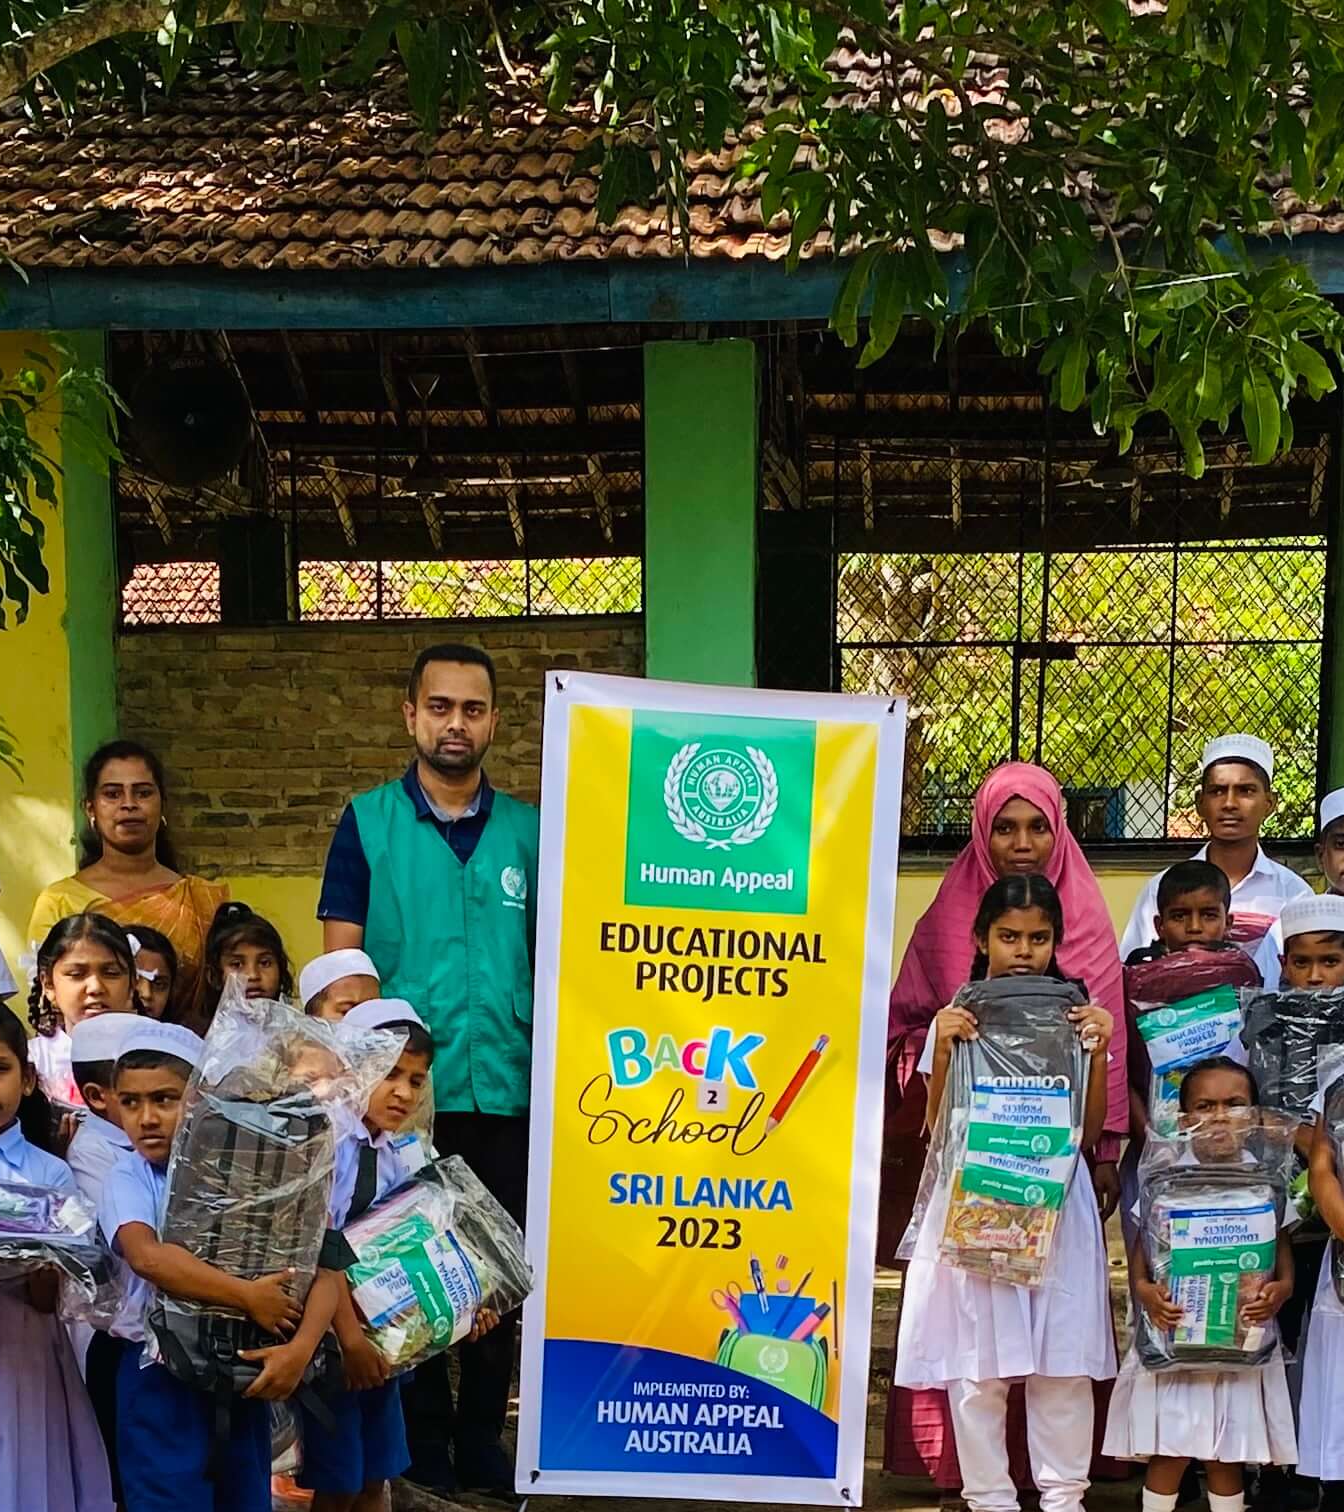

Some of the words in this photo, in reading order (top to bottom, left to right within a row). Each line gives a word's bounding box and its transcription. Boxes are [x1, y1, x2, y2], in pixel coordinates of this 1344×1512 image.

[687, 754, 721, 786] HUMAN
[725, 755, 757, 788] APPEAL
[691, 805, 750, 827] AUSTRALIA
[639, 863, 716, 888] Human
[720, 868, 794, 895] Appeal
[599, 921, 828, 964] EDUCATIONAL
[635, 961, 789, 1002] PROJECTS
[707, 1089, 719, 1105] 2
[579, 1073, 768, 1156] School
[609, 1173, 664, 1207] SRI
[674, 1176, 793, 1211] LANKA
[656, 1216, 743, 1250] 2023
[633, 1381, 726, 1399] IMPLEMENTED
[729, 1385, 750, 1399] BY:
[597, 1401, 690, 1426] HUMAN
[694, 1403, 784, 1429] APPEAL
[624, 1430, 753, 1455] AUSTRALIA
